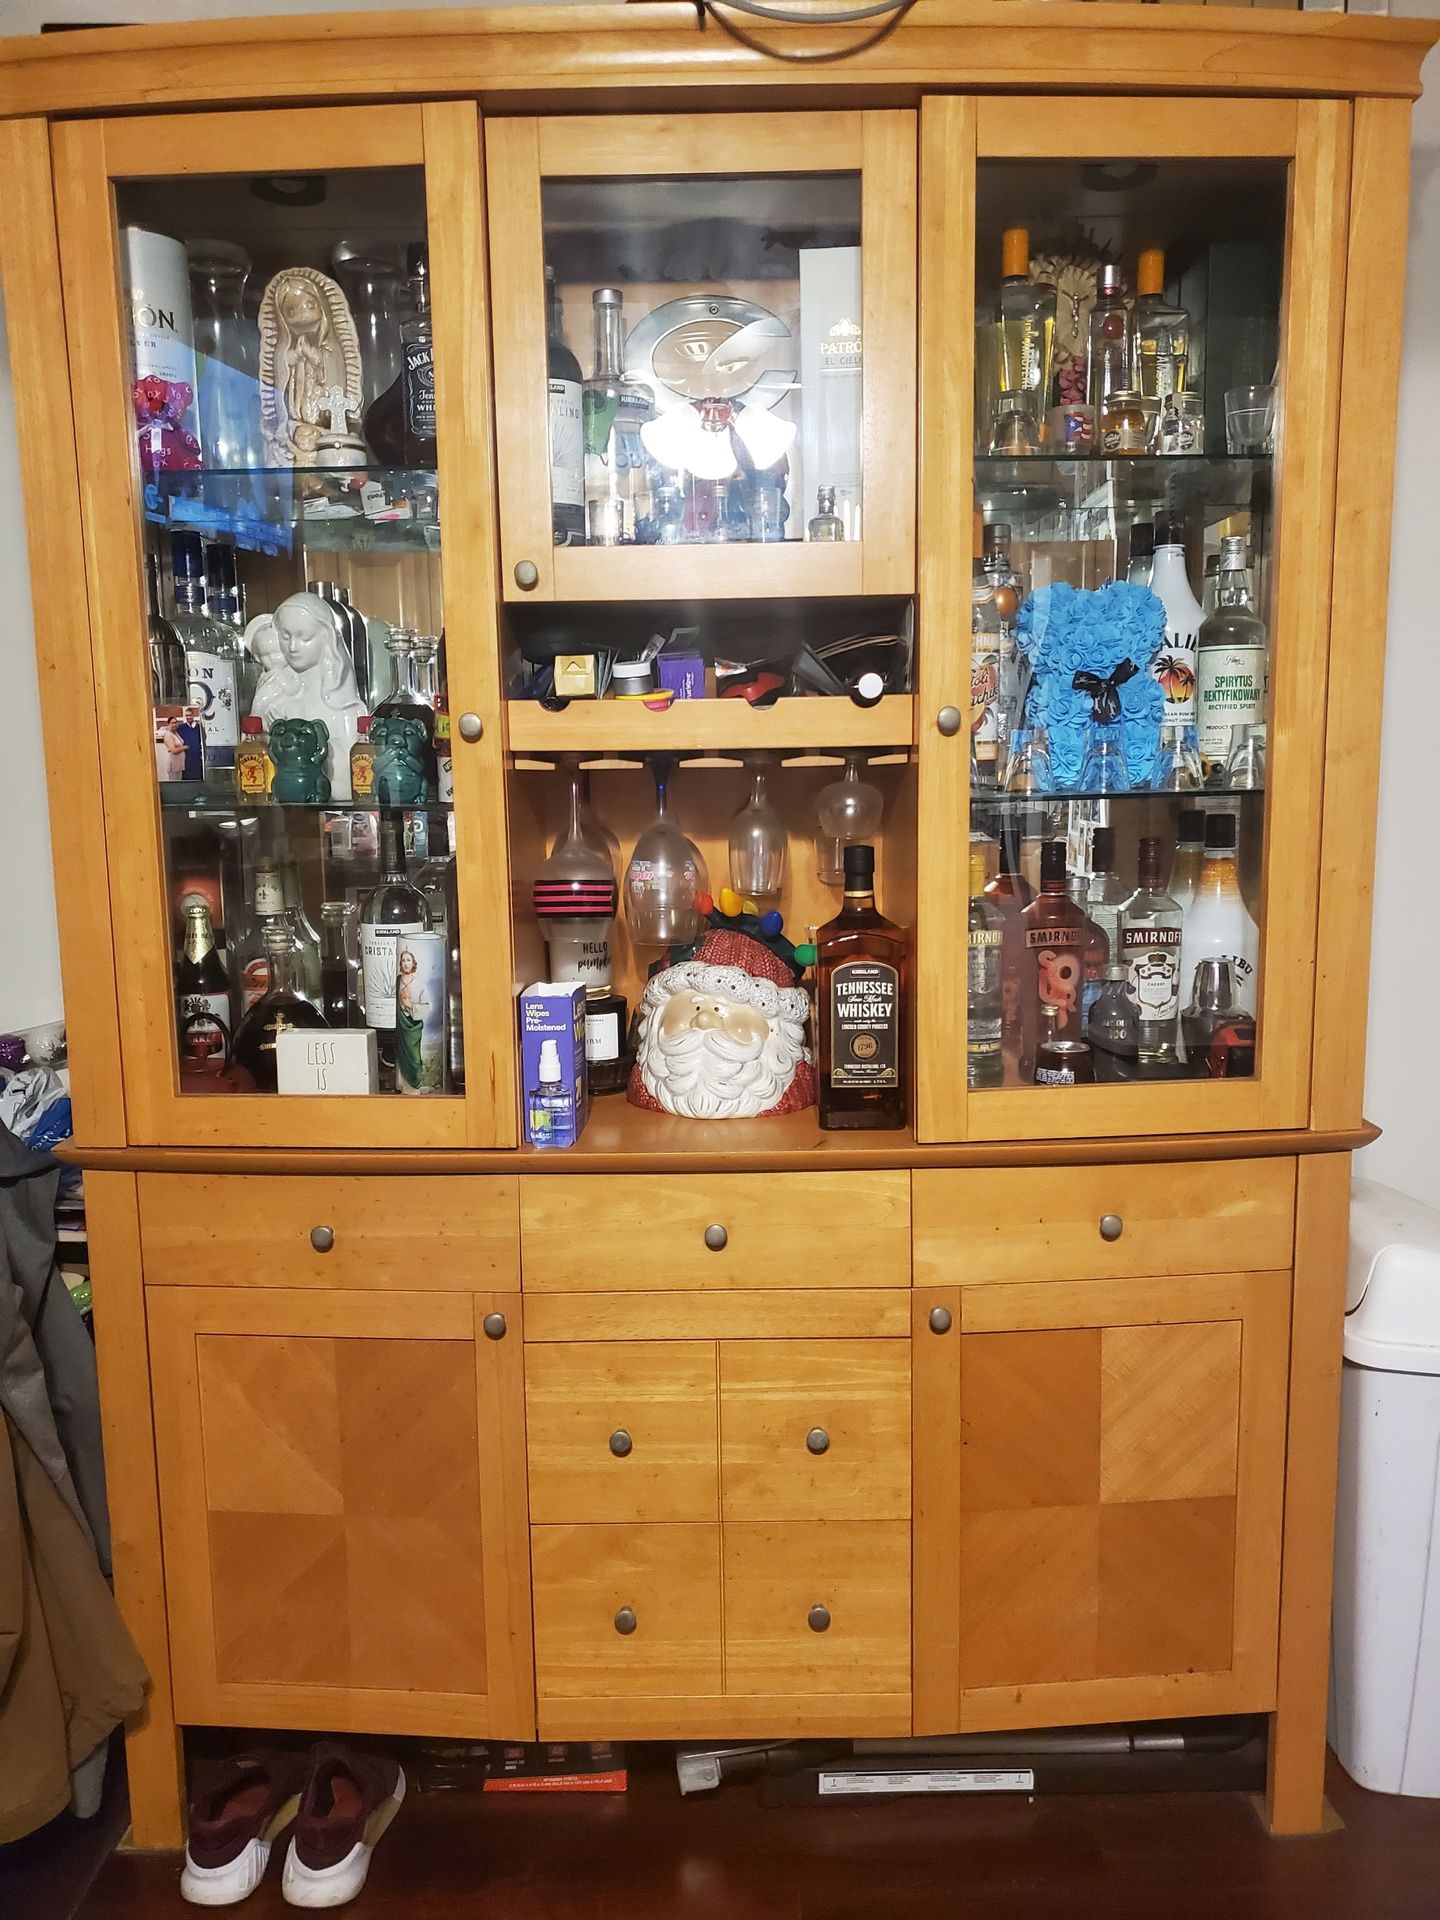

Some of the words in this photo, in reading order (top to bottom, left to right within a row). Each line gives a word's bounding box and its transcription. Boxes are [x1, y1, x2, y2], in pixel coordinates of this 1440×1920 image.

[407, 351, 430, 371] JACK
[826, 357, 834, 365] EL
[1215, 675, 1253, 688] SPIRYTUS
[1204, 688, 1261, 702] REKTYFIKOWANY
[365, 946, 393, 956] CRISTA
[583, 941, 608, 954] HELLO
[836, 981, 894, 996] TENNESSEE
[525, 1010, 550, 1018] Wipes
[837, 1003, 893, 1017] WHISKEY
[307, 1042, 335, 1065] LESS
[317, 1068, 327, 1090] IS
